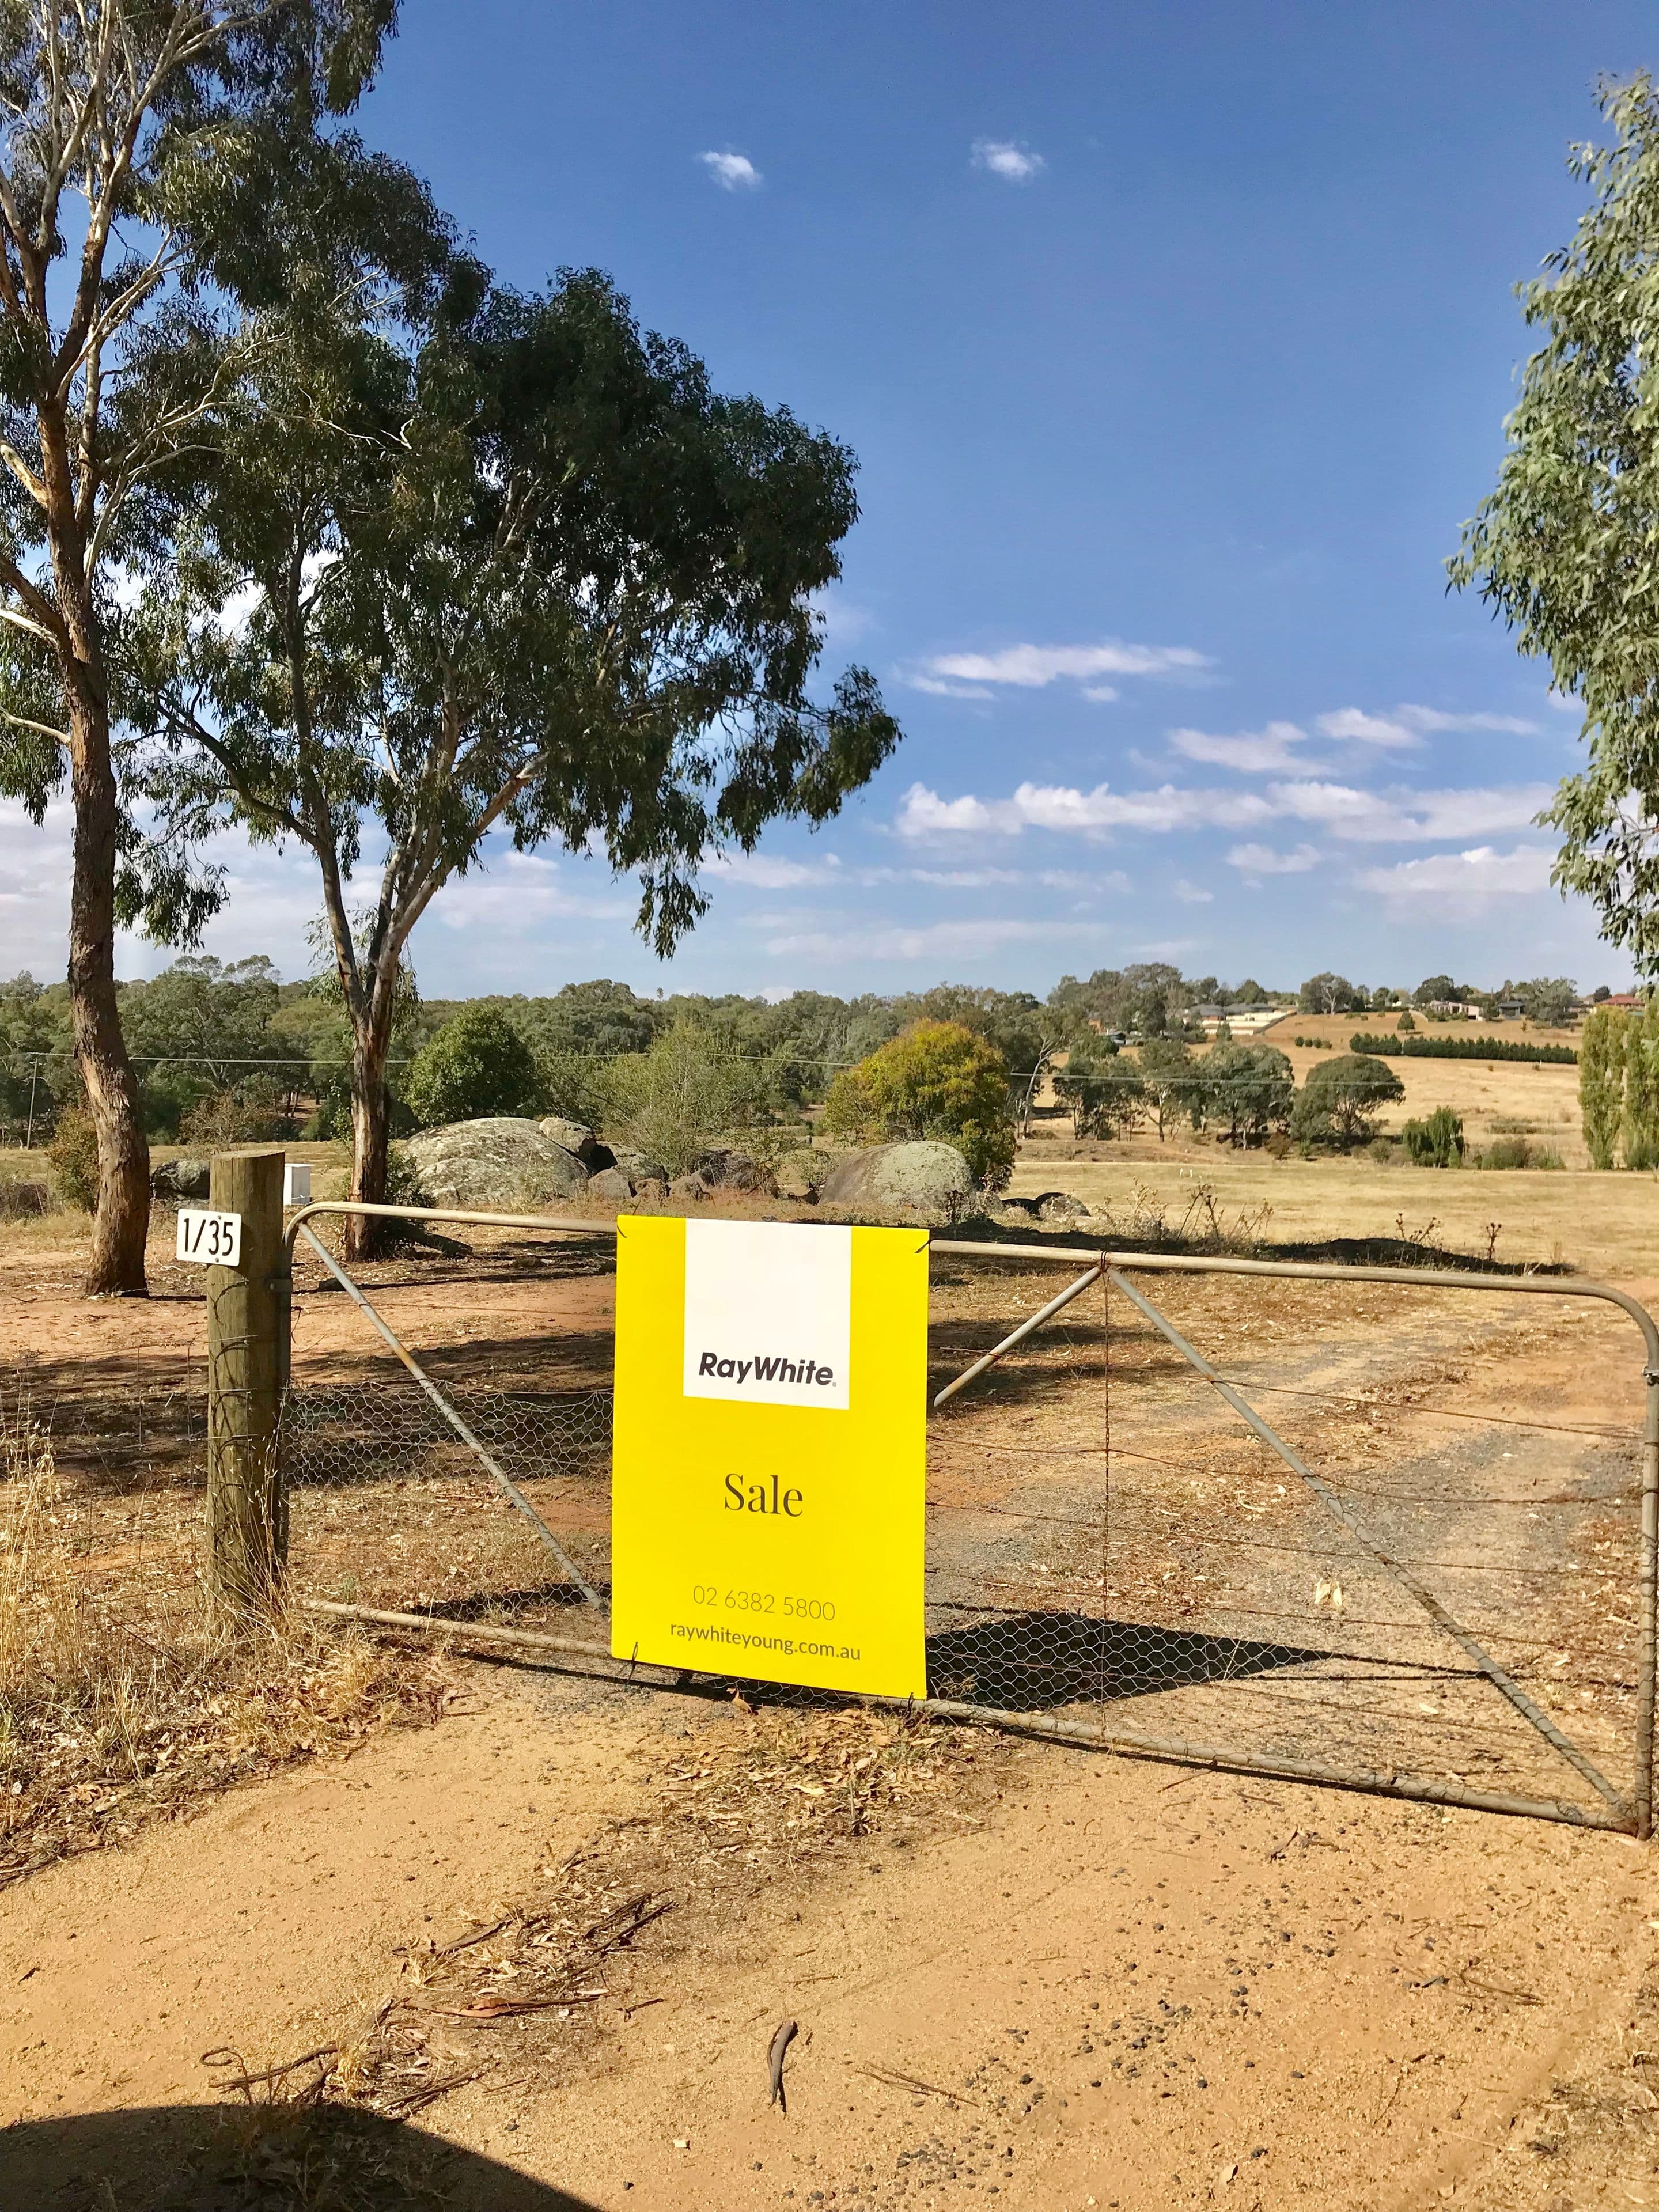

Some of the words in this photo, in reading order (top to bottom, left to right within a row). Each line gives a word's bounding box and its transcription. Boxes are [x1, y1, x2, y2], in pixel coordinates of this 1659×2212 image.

[184, 1218, 233, 1257] 1/35
[724, 1473, 803, 1517] Sale
[693, 1585, 717, 1607] 02
[725, 1589, 775, 1614] 6382
[783, 1596, 835, 1621] 5800
[671, 1623, 861, 1660] raywhiteyoung.com.au
